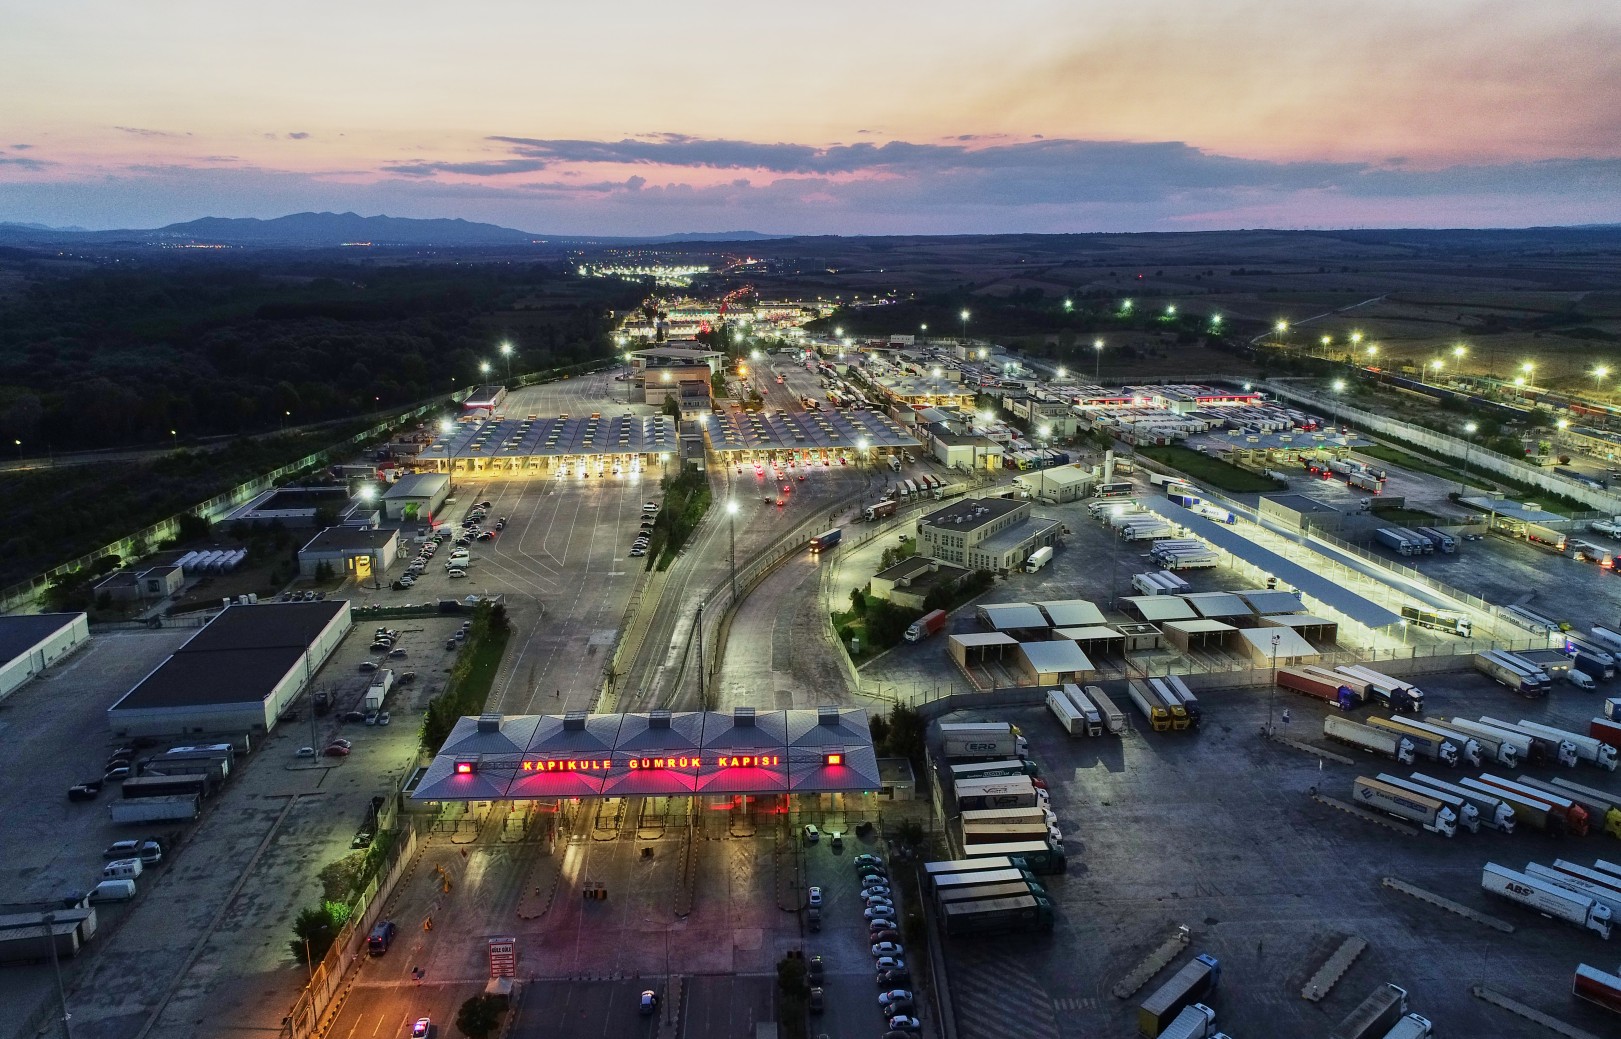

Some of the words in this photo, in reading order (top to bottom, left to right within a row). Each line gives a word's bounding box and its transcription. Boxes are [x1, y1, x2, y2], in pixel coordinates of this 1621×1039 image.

[523, 760, 611, 771] KAPIKULE
[629, 757, 700, 769] GÜMRÜK
[718, 756, 778, 767] KAPISI
[1505, 882, 1530, 896] ABS
